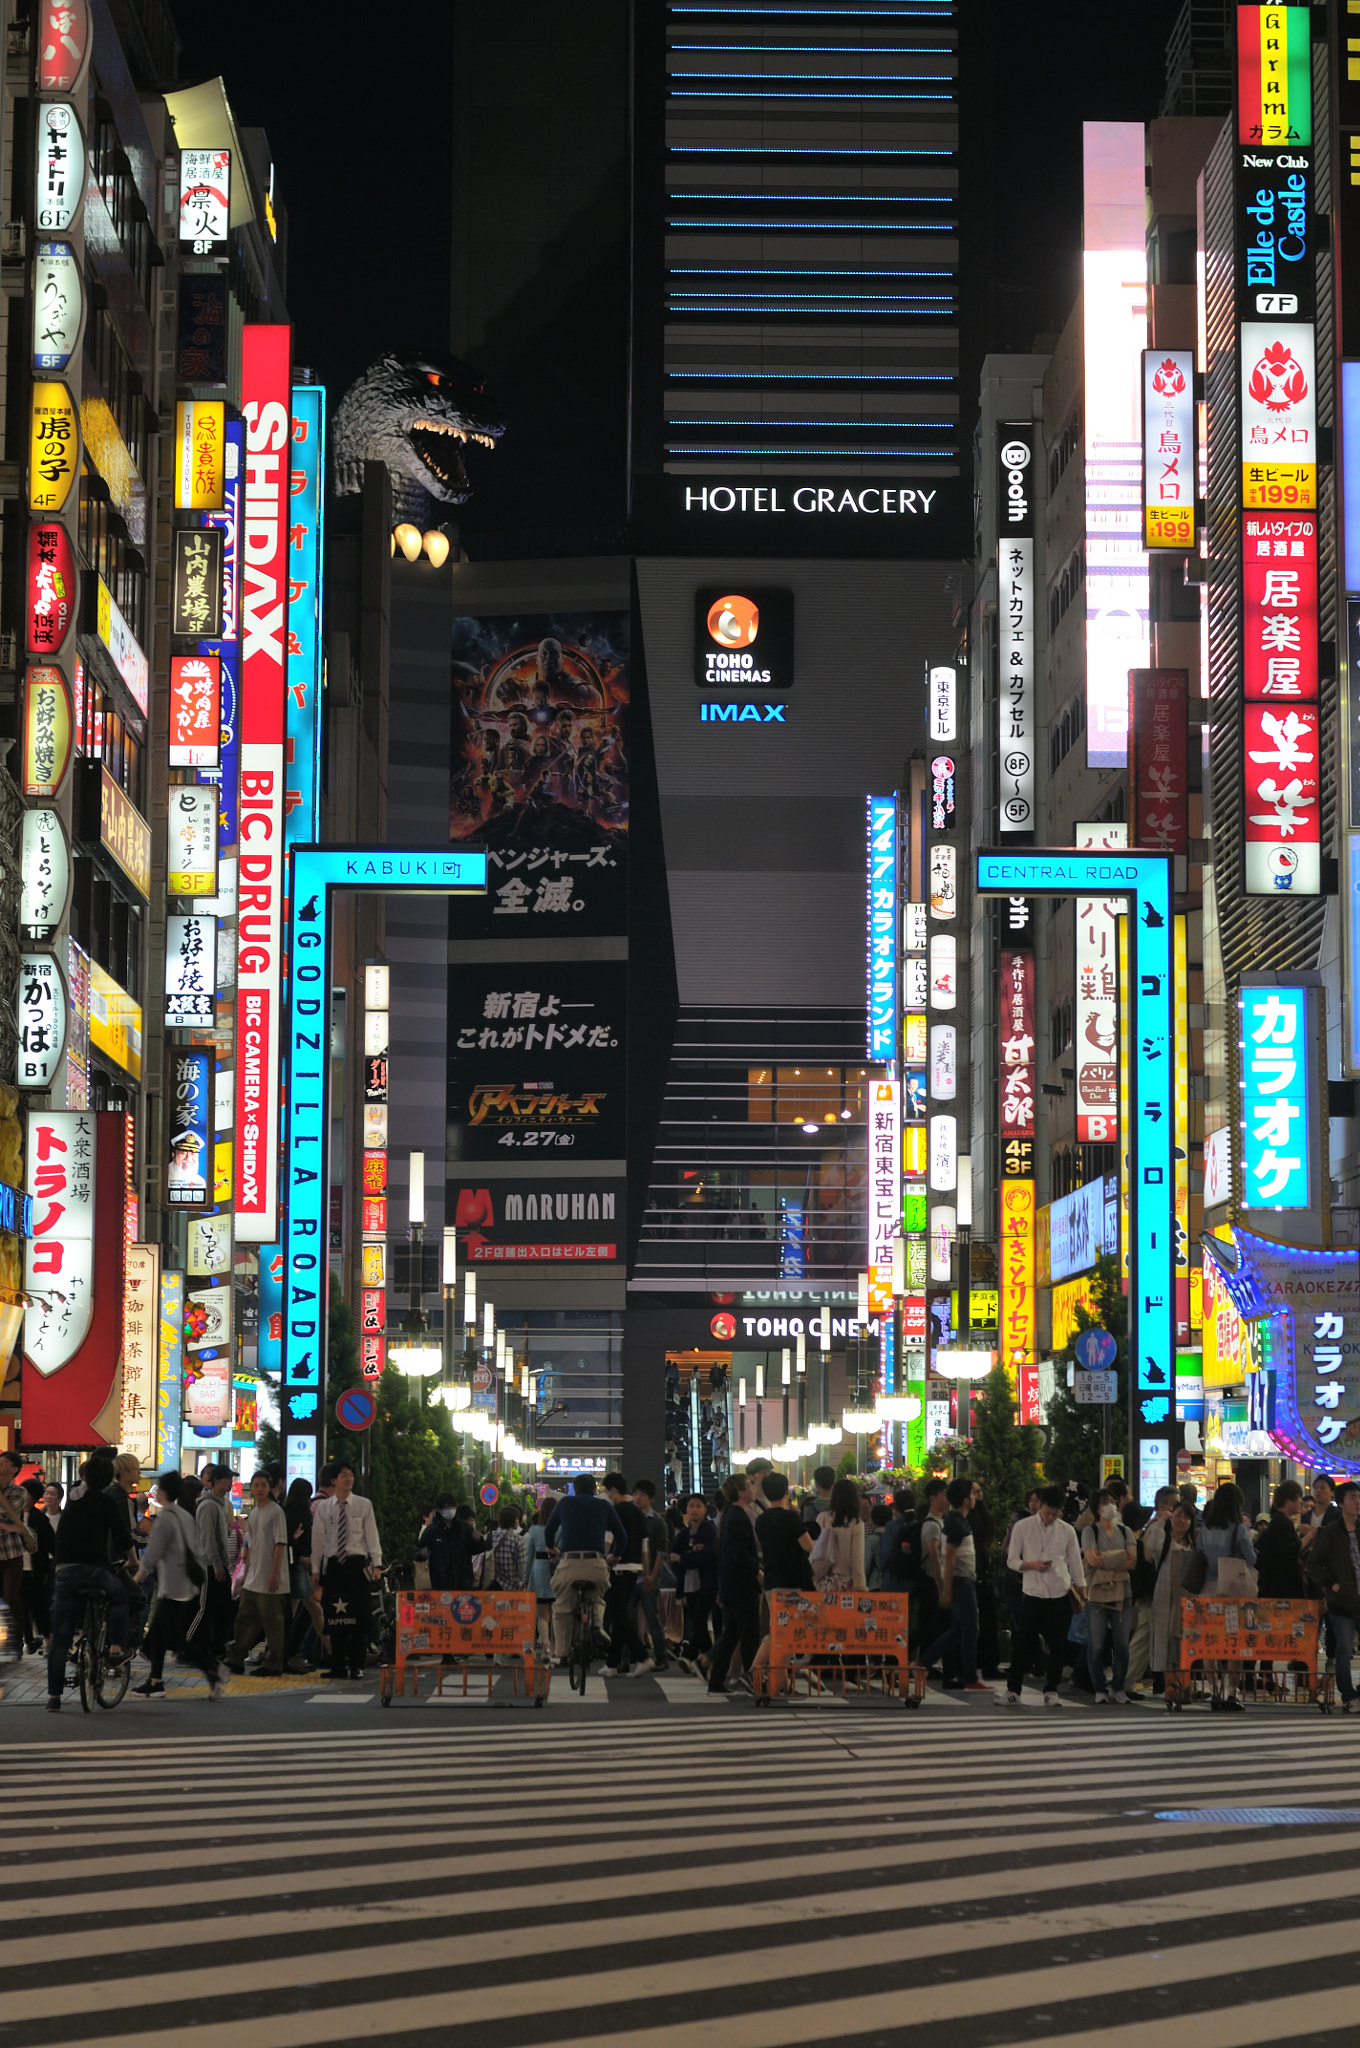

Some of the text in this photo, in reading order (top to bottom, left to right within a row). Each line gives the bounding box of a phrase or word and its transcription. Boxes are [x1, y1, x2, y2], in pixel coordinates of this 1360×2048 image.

[1264, 13, 1286, 115] Garam
[44, 76, 70, 87] 7F
[1249, 124, 1301, 140] ガラム
[47, 128, 67, 196] ヤキトリ
[185, 153, 211, 166] 海鮮
[1243, 154, 1309, 169] New Club
[185, 167, 224, 180] 居酒屋
[40, 210, 69, 227] 6F
[1278, 173, 1306, 262] Castle
[193, 239, 213, 254] 8F
[1247, 188, 1275, 287] Elle de
[40, 244, 66, 255] 酒処
[1261, 297, 1294, 312] 7F
[41, 356, 60, 367] 5F
[1249, 425, 1309, 445] 鳥メロ
[36, 417, 71, 482] 虎の子
[1158, 430, 1182, 500] 鳥メロ
[1249, 466, 1310, 483] 生ビール
[1001, 441, 1031, 522] Booth
[34, 494, 56, 506] 4F
[686, 486, 937, 514] HOTEL GRACERY
[1258, 484, 1299, 504] 199
[1150, 510, 1190, 520] 生ビール
[241, 400, 288, 666] SHIDAX
[1155, 521, 1190, 538] 199
[1246, 520, 1314, 537] 新しいタイプの
[1256, 540, 1305, 557] 居酒屋
[180, 535, 212, 622] 山内農場
[188, 620, 204, 632] 5F
[1260, 570, 1301, 695] 居楽屋
[1009, 548, 1025, 739] ネットカフェ & カプセル
[706, 653, 753, 669] TOHO
[706, 670, 771, 683] CINEMAS
[174, 683, 197, 742] さかい
[193, 677, 215, 728] 焼肉屋
[701, 703, 786, 722] IMAX
[937, 681, 950, 735] 東京ビル
[35, 688, 56, 783] お好み焼き
[1152, 704, 1170, 762] 居楽屋
[181, 749, 204, 764] 4F
[1010, 758, 1026, 770] 8F
[1010, 804, 1026, 816] 5F
[181, 875, 204, 889] 3F
[239, 770, 274, 974] BIC DRUG
[987, 865, 1138, 880] CENTRAL ROAD
[27, 926, 49, 939] 1F
[872, 808, 895, 1052] 747 カラオケランド
[179, 918, 204, 993] お好み焼
[24, 965, 52, 976] 新宿
[1011, 955, 1025, 1032] 手作り居酒屋
[22, 978, 53, 1053] かっぱ
[245, 996, 261, 1027] BIC
[457, 1023, 619, 1050] これがトドメだ。
[25, 1063, 47, 1077] B1
[1002, 1033, 1035, 1127] 甘太郎
[176, 1058, 201, 1126] 海の家
[1251, 995, 1301, 1199] カラオケ
[290, 931, 322, 1338] GODZILLA ROAD
[1141, 973, 1166, 1314] ゴジラロード
[1006, 1139, 1032, 1157] 4F
[71, 1116, 92, 1204] 大衆酒場
[1006, 1159, 1032, 1174] 3F
[364, 1159, 384, 1190] 麻雀
[874, 1111, 894, 1264] 新宿東宝ビル店
[33, 1127, 67, 1275] トラノコ
[505, 1193, 615, 1221] MARUHAN
[474, 1246, 609, 1259] 2F店舗出入口はビル左側
[742, 1317, 804, 1337] TOHO
[1313, 1311, 1347, 1444] カラオケ
[126, 1444, 140, 1453] 2F
[546, 1457, 607, 1467] ACORN
